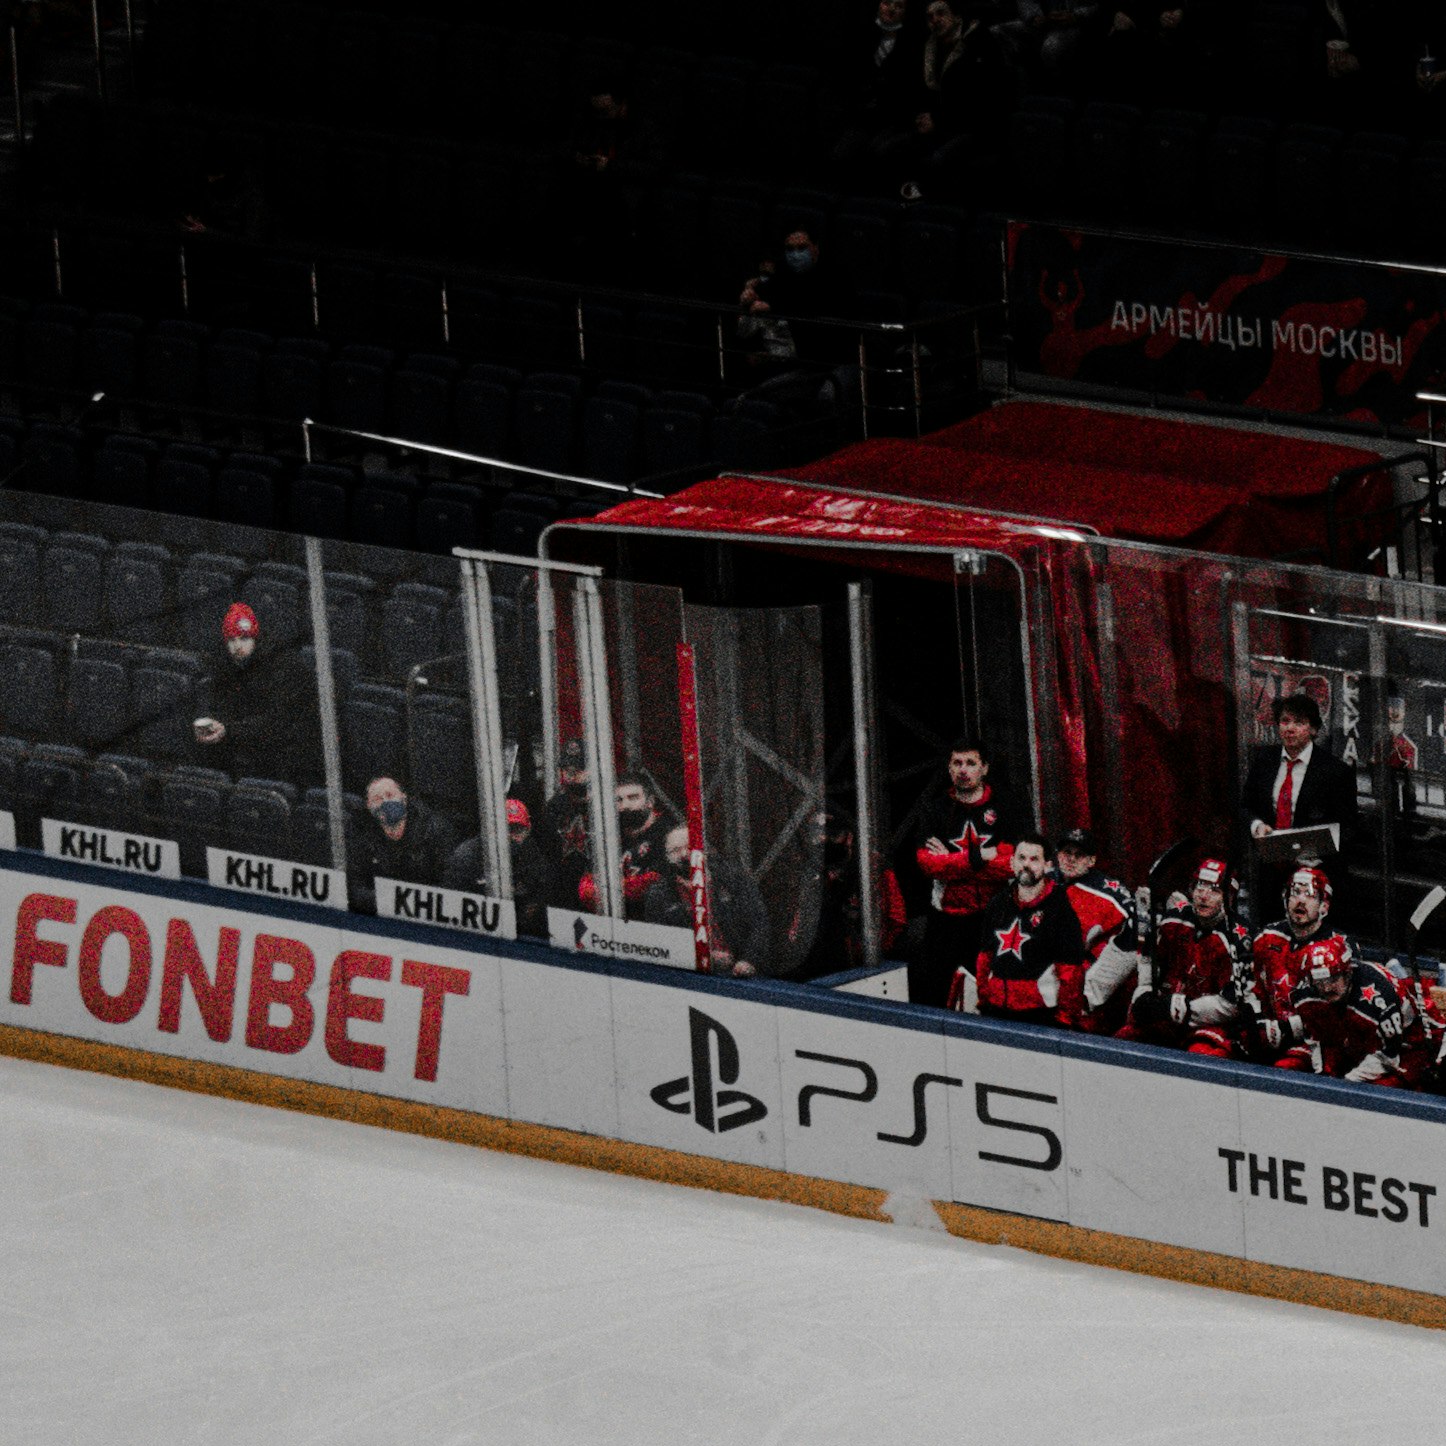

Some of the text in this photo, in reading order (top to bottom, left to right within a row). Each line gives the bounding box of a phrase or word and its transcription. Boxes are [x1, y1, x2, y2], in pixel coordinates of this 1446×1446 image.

[1110, 299, 1403, 367] АРМЕЙЦЫ МОСКВЫ
[60, 826, 162, 872] KHL.RU
[226, 855, 330, 902] KHL.RU
[394, 885, 501, 932] KHL.RU
[591, 933, 671, 960] Ростелеком
[10, 892, 472, 1082] FONBET
[795, 1049, 1062, 1172] PS5
[1218, 1147, 1308, 1206] THE
[1322, 1165, 1437, 1229] BEST
